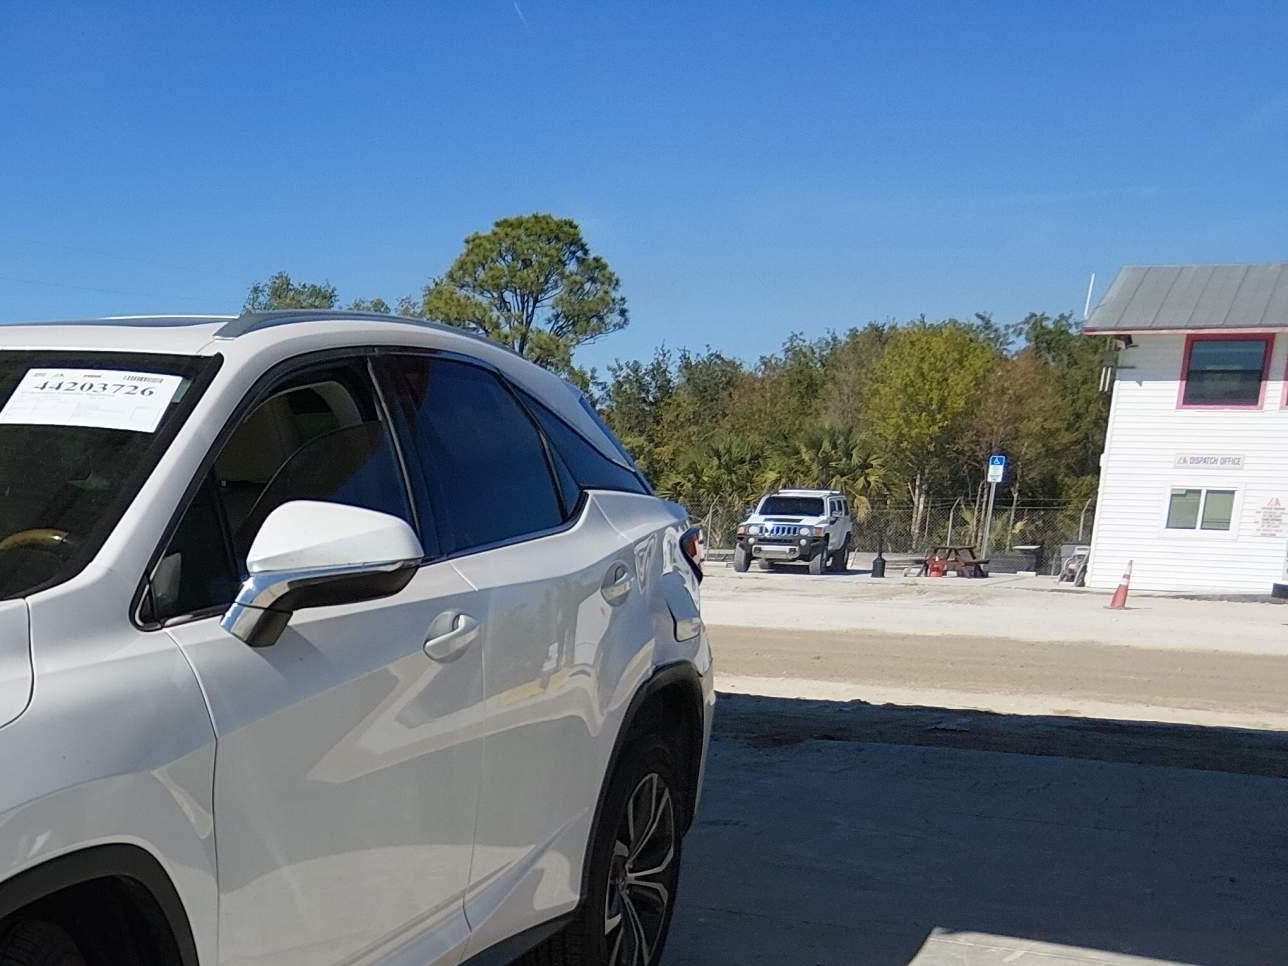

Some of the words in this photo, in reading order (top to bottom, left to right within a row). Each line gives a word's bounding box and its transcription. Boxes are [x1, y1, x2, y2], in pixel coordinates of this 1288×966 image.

[33, 381, 154, 397] 44203726
[1189, 456, 1218, 465] DISPATCH
[1220, 457, 1241, 466] OFFICE
